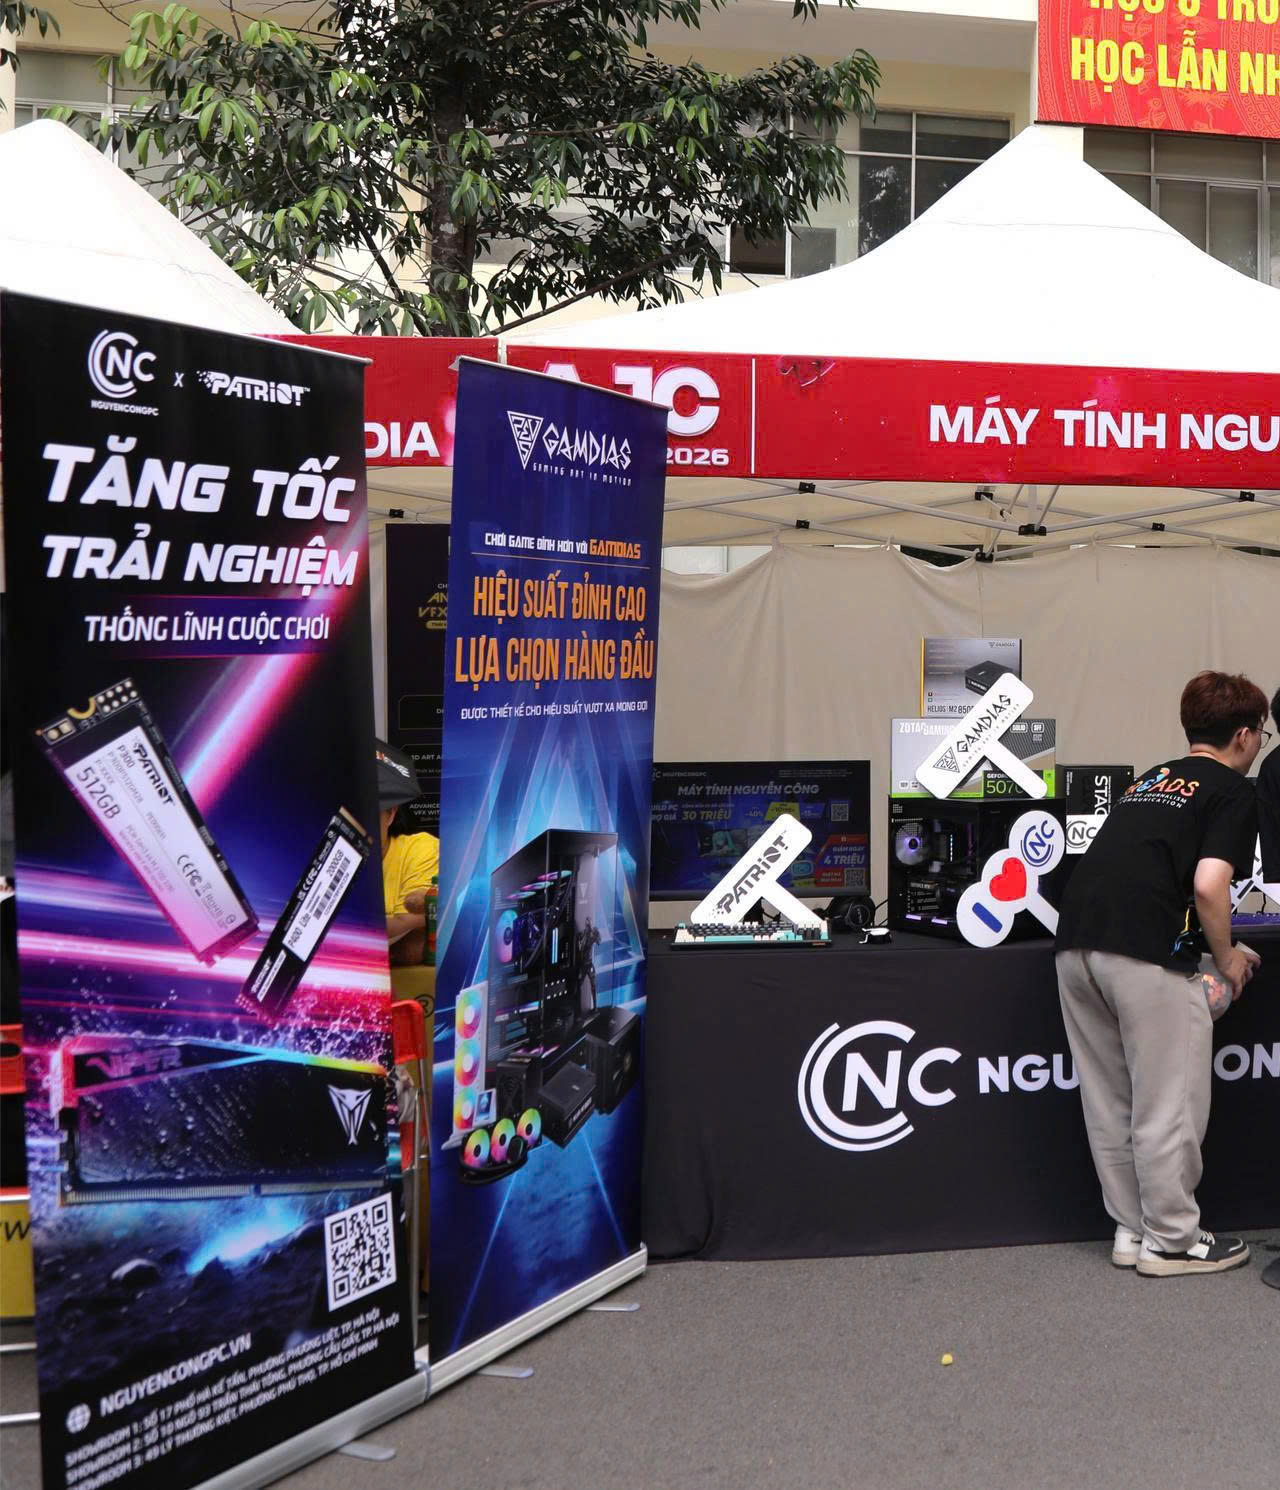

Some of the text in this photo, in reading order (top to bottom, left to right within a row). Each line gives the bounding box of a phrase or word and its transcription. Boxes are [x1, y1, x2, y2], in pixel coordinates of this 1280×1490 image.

[1071, 37, 1145, 92] HỌC
[1157, 29, 1227, 92] LẪN
[90, 399, 159, 416] NGUYENCONGPC
[543, 363, 720, 437] JC
[930, 395, 1039, 445] MÁY
[1054, 399, 1166, 449] TÍNH
[542, 422, 631, 470] GAMDIAS
[667, 447, 729, 465] 2026
[42, 434, 356, 523] TĂNG TỐC
[42, 523, 359, 597] TRẢI NGHIỆM
[485, 532, 506, 547] CHƠI
[509, 535, 535, 549] GAME
[589, 539, 641, 559] GAMDIAS
[473, 570, 646, 625] HIỆU SUẤT ĐỈNH CAO
[84, 605, 329, 645] THỐNG LĨNH CUỘC CHƠI
[455, 627, 654, 691] LỰA CHỌN HÀNG ĐẦU
[461, 706, 488, 719] ĐƯỢC
[490, 702, 513, 718] THIẾT
[514, 703, 525, 717] KẾ
[526, 705, 542, 716] CHO
[544, 703, 562, 718] HIỆU
[563, 700, 584, 714] SUẤT
[605, 702, 615, 713] XA
[616, 701, 636, 712] MONG
[956, 694, 1011, 753] GAMDIAS
[76, 766, 122, 820] 512GB
[678, 779, 819, 796] MÁY TÍNH NGUYỄN CÔNG
[100, 1334, 251, 1418] NGUYENCONGPC.VN
